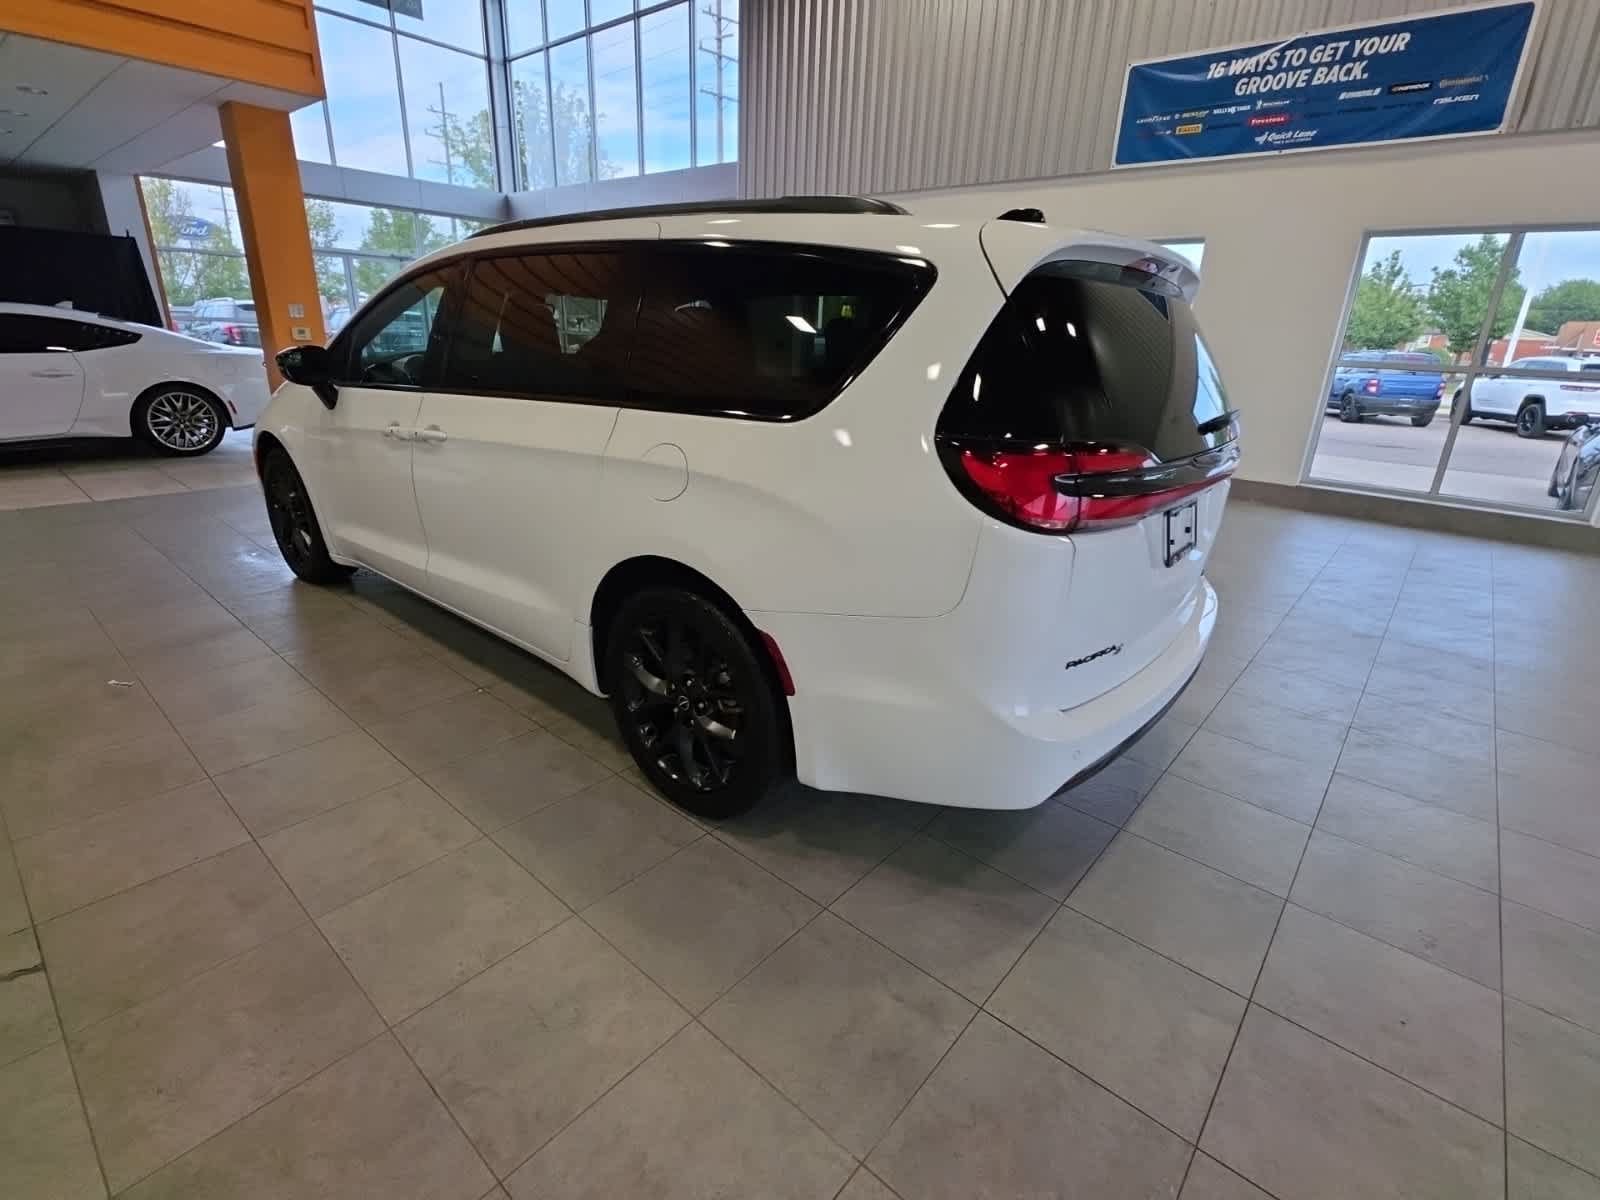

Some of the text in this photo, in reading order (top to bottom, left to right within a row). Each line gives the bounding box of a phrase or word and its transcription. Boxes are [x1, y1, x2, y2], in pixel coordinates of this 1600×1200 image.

[1206, 32, 1411, 80] 16 WAYS TO GET YOUR
[1234, 69, 1311, 96] GROOVE
[1311, 60, 1369, 86] BACK.
